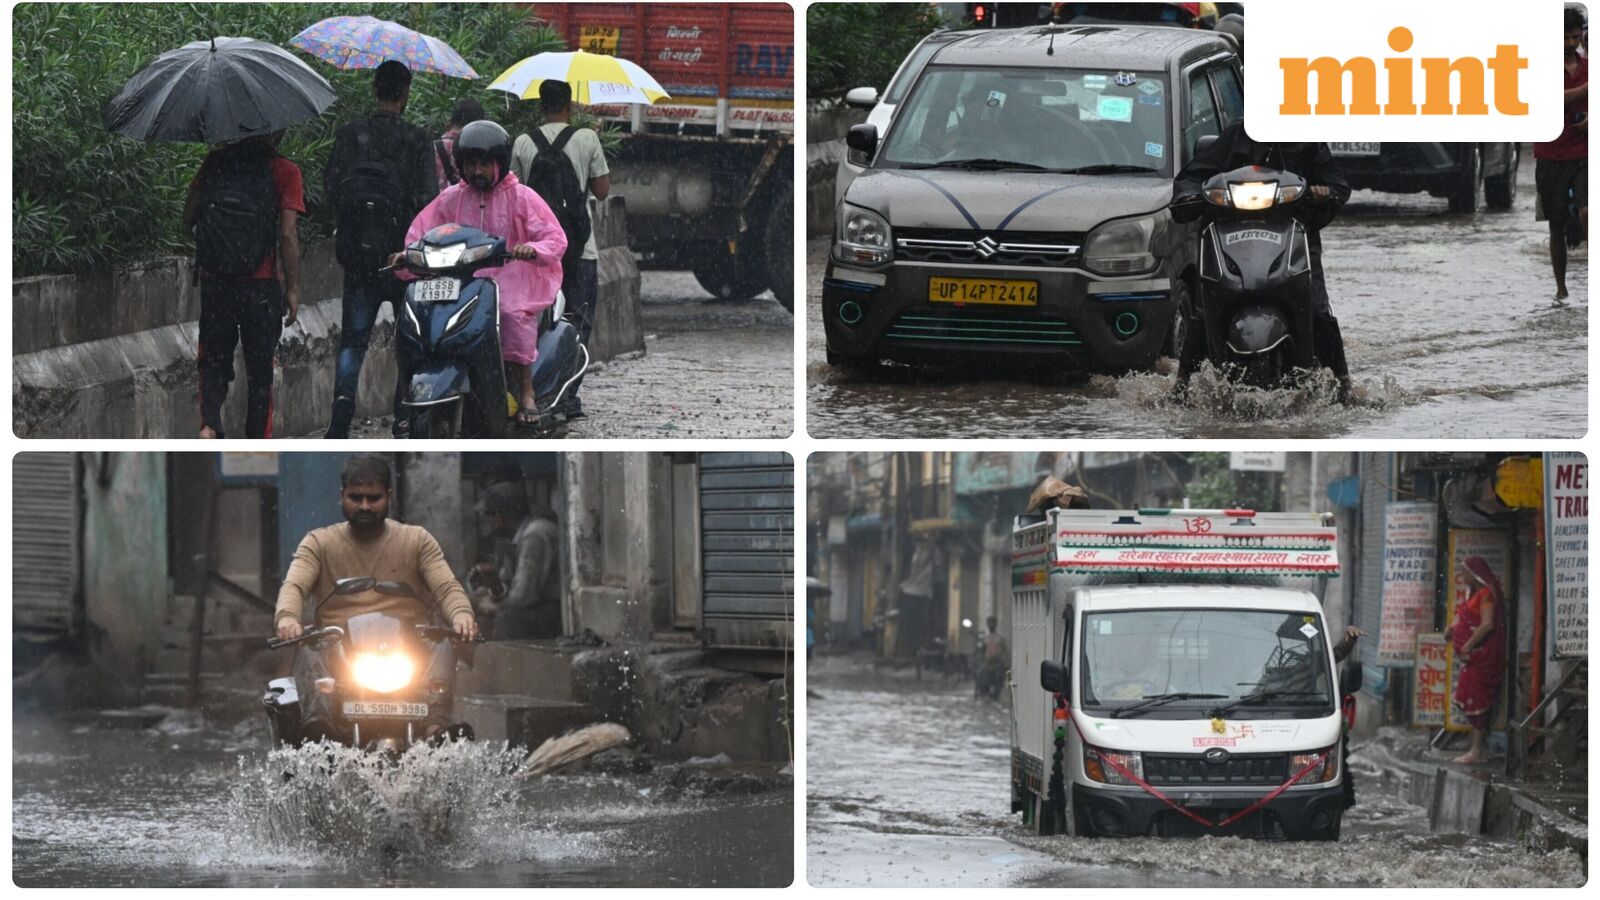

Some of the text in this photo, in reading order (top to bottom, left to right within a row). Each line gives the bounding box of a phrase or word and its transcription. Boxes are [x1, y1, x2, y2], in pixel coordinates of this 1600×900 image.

[646, 106, 698, 118] COMPANY
[733, 110, 762, 121] PLOT
[422, 281, 454, 291] DL6SB
[421, 290, 454, 300] K1917
[940, 282, 1037, 302] UP14PT2414
[1074, 549, 1099, 560] शुभ
[1155, 551, 1192, 561] सहारा
[1297, 553, 1331, 563] लाभ
[1389, 560, 1428, 569] TRADE
[1385, 571, 1434, 581] LINKERS
[355, 703, 366, 713] DL
